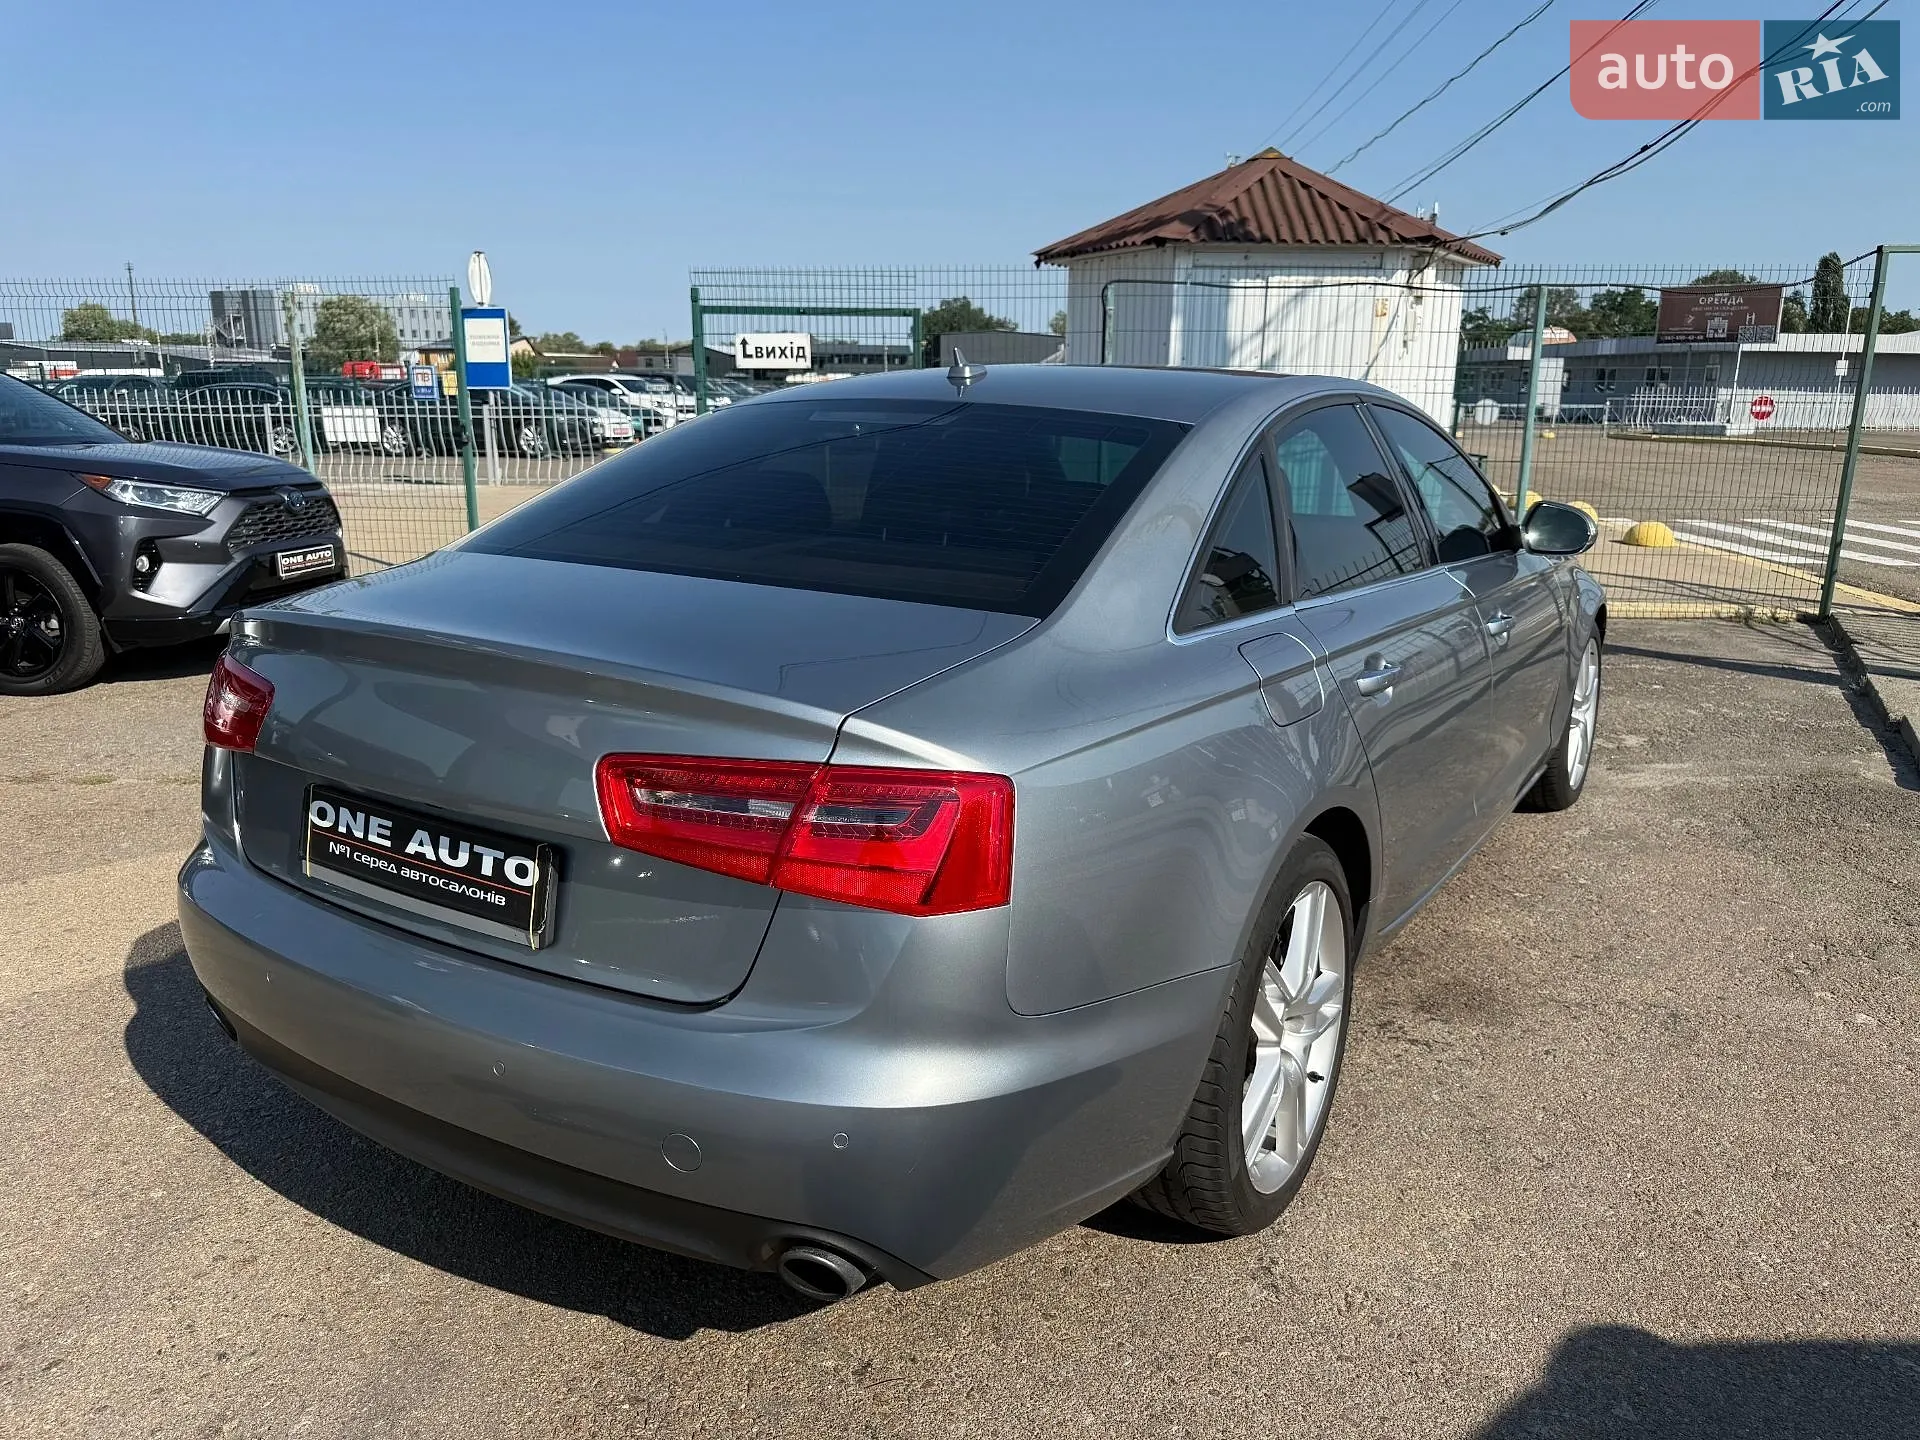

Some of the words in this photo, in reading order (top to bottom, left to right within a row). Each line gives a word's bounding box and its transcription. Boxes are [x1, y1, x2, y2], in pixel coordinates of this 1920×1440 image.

[1699, 296, 1744, 306] ОРЕНДА
[754, 341, 807, 363] вихід
[282, 555, 304, 565] ONE
[306, 550, 332, 561] AUTO
[309, 800, 393, 848] ONE
[404, 828, 540, 887] AUTO
[328, 841, 351, 859] №1
[353, 851, 398, 874] серед
[400, 866, 506, 906] автосалонів
